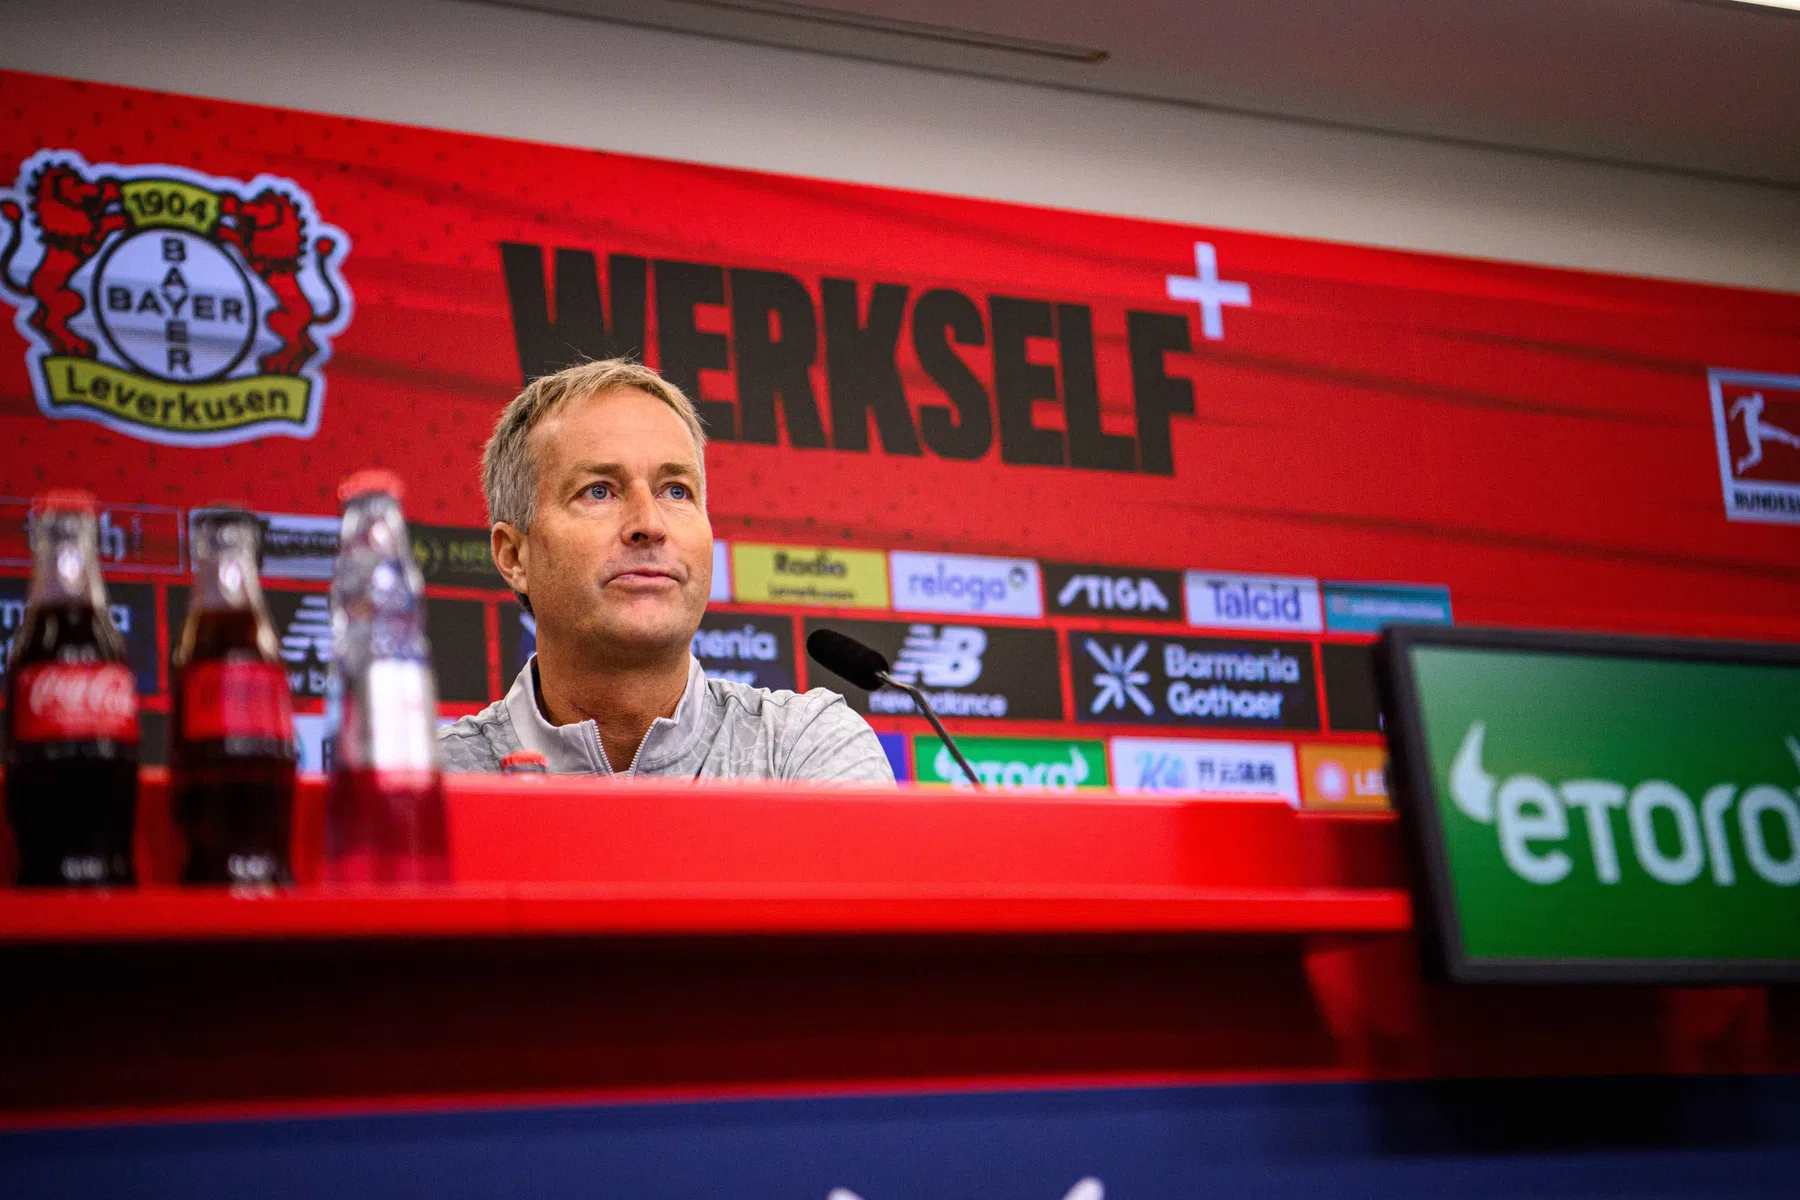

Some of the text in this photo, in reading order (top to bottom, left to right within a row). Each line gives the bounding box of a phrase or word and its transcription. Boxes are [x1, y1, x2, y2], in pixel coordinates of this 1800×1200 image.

[131, 190, 207, 223] 1904
[107, 286, 244, 324] BAYER
[162, 237, 191, 373] BAYER
[66, 365, 289, 423] Leverkusen
[1207, 580, 1301, 621] Talcid
[1163, 643, 1300, 683] Barmenia
[1167, 681, 1284, 719] Gothaer
